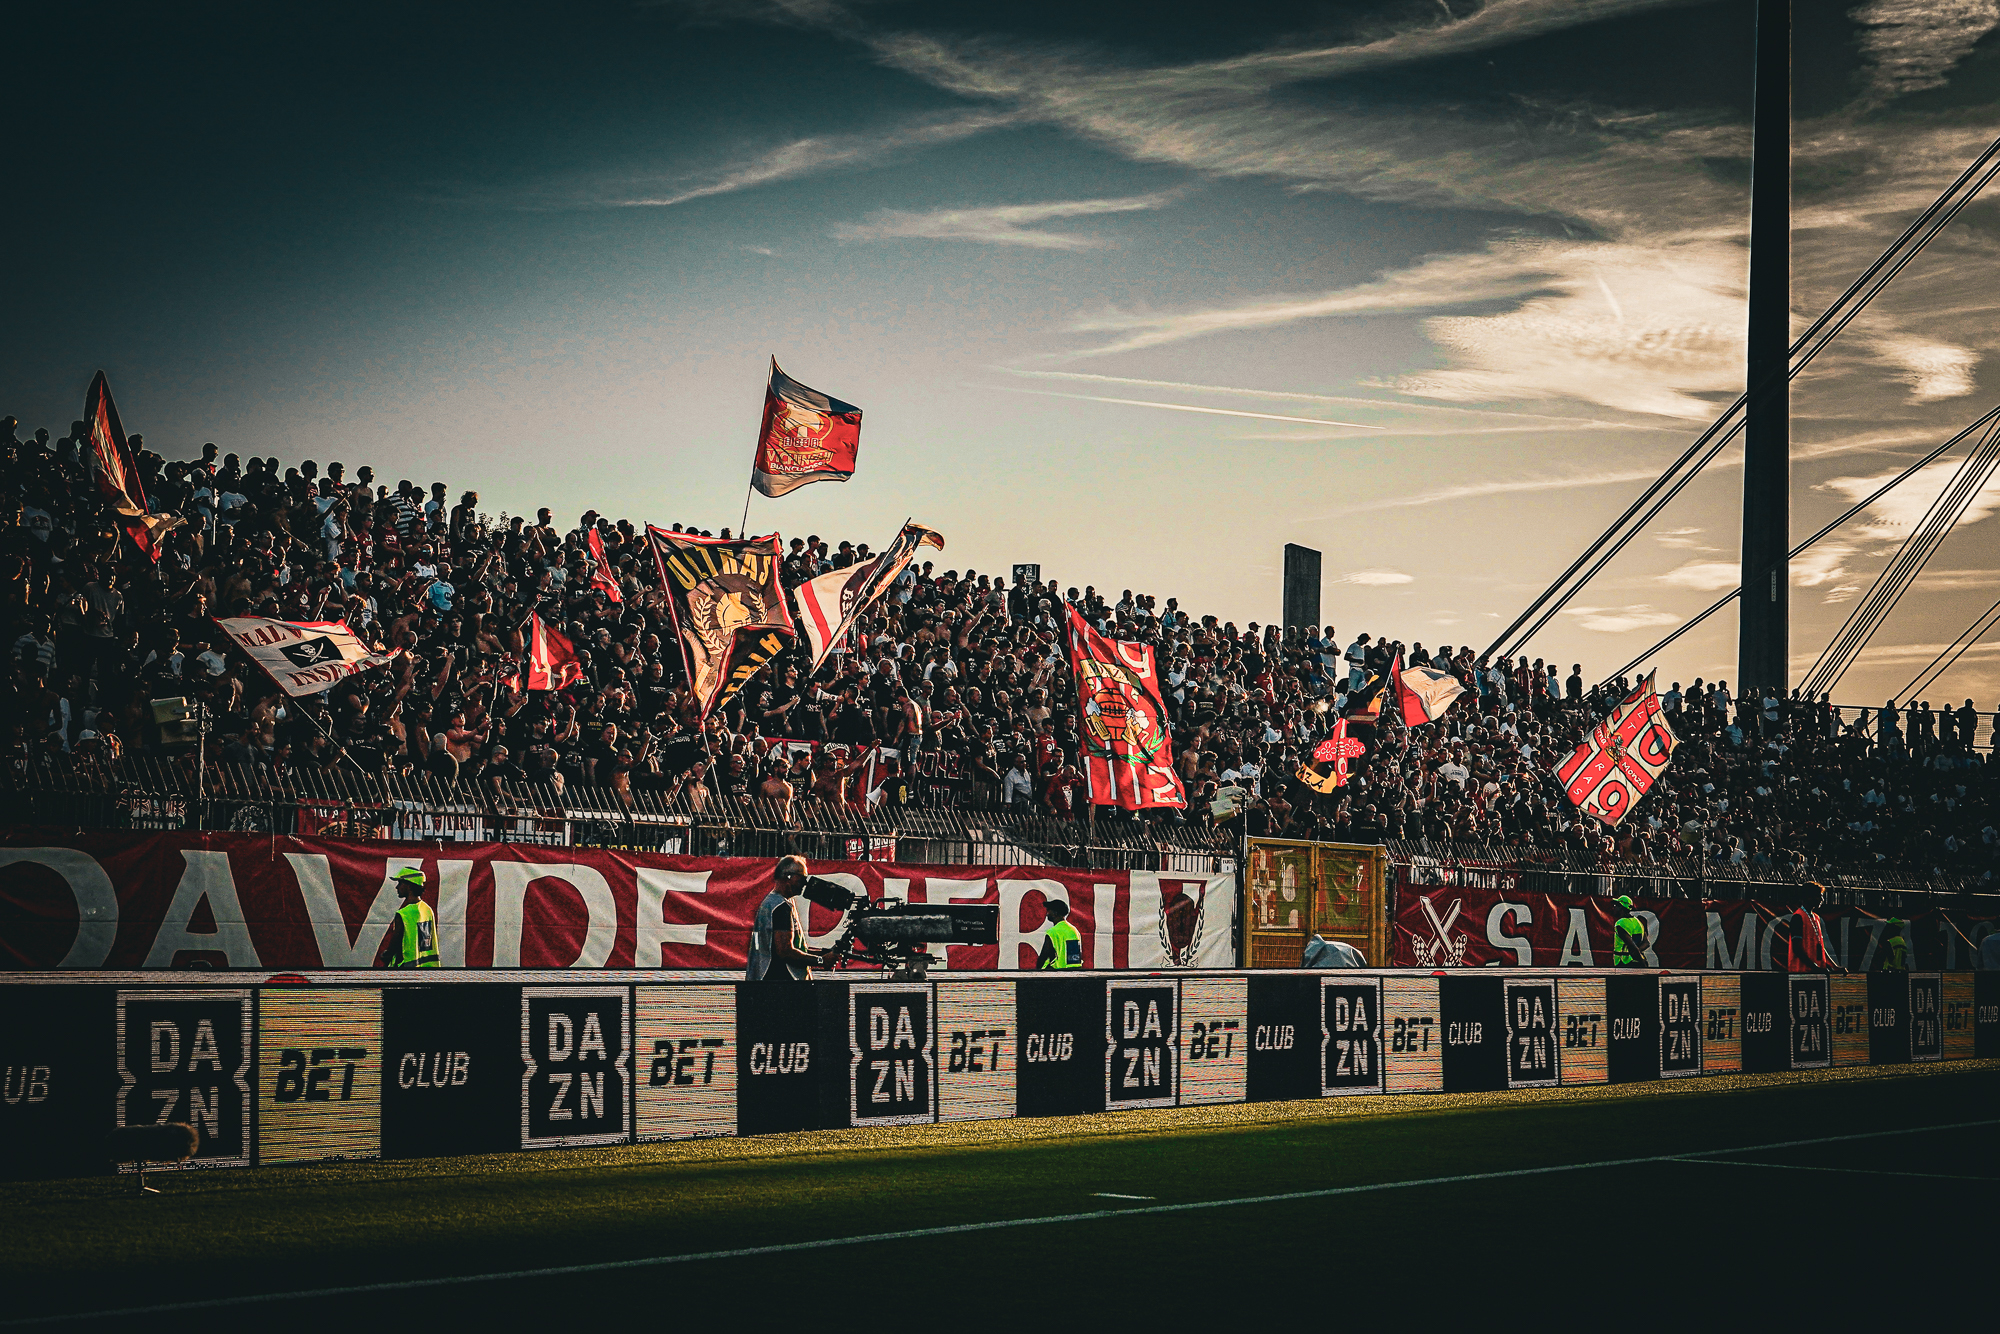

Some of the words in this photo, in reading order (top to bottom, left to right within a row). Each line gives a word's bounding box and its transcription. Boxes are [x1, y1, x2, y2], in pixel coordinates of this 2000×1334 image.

[667, 546, 772, 590] ULTRAS
[1621, 761, 1646, 789] Monza
[1124, 1001, 1161, 1039] DA
[1336, 997, 1368, 1031] DA
[1517, 997, 1546, 1029] DA
[1669, 993, 1690, 1023] DA
[1706, 1009, 1736, 1040] BET
[1747, 1012, 1772, 1033] CLUB
[1835, 1003, 1864, 1035] BET
[1873, 1008, 1895, 1027] CLUB
[1947, 1000, 1972, 1030] BET
[1979, 1005, 1998, 1023] CLUB
[151, 1020, 222, 1072] DA
[549, 1013, 606, 1062] DA
[871, 1007, 915, 1050] DA
[1190, 1019, 1239, 1061] BET
[1255, 1025, 1294, 1051] CLUB
[1392, 1017, 1433, 1054] BET
[1449, 1022, 1482, 1046] CLUB
[1565, 1014, 1601, 1049] BET
[1613, 1017, 1640, 1040] CLUB
[1670, 1029, 1691, 1060] ZN
[649, 1039, 725, 1087] BET
[750, 1043, 809, 1075] CLUB
[949, 1031, 1006, 1073] BET
[1026, 1033, 1073, 1062] CLUB
[1124, 1048, 1160, 1087] ZN
[1337, 1040, 1367, 1075] ZN
[1519, 1037, 1546, 1069] ZN
[4, 1066, 50, 1104] UB
[274, 1050, 367, 1103] BET
[399, 1052, 470, 1089] CLUB
[549, 1072, 604, 1119] ZN
[871, 1059, 914, 1102] ZN
